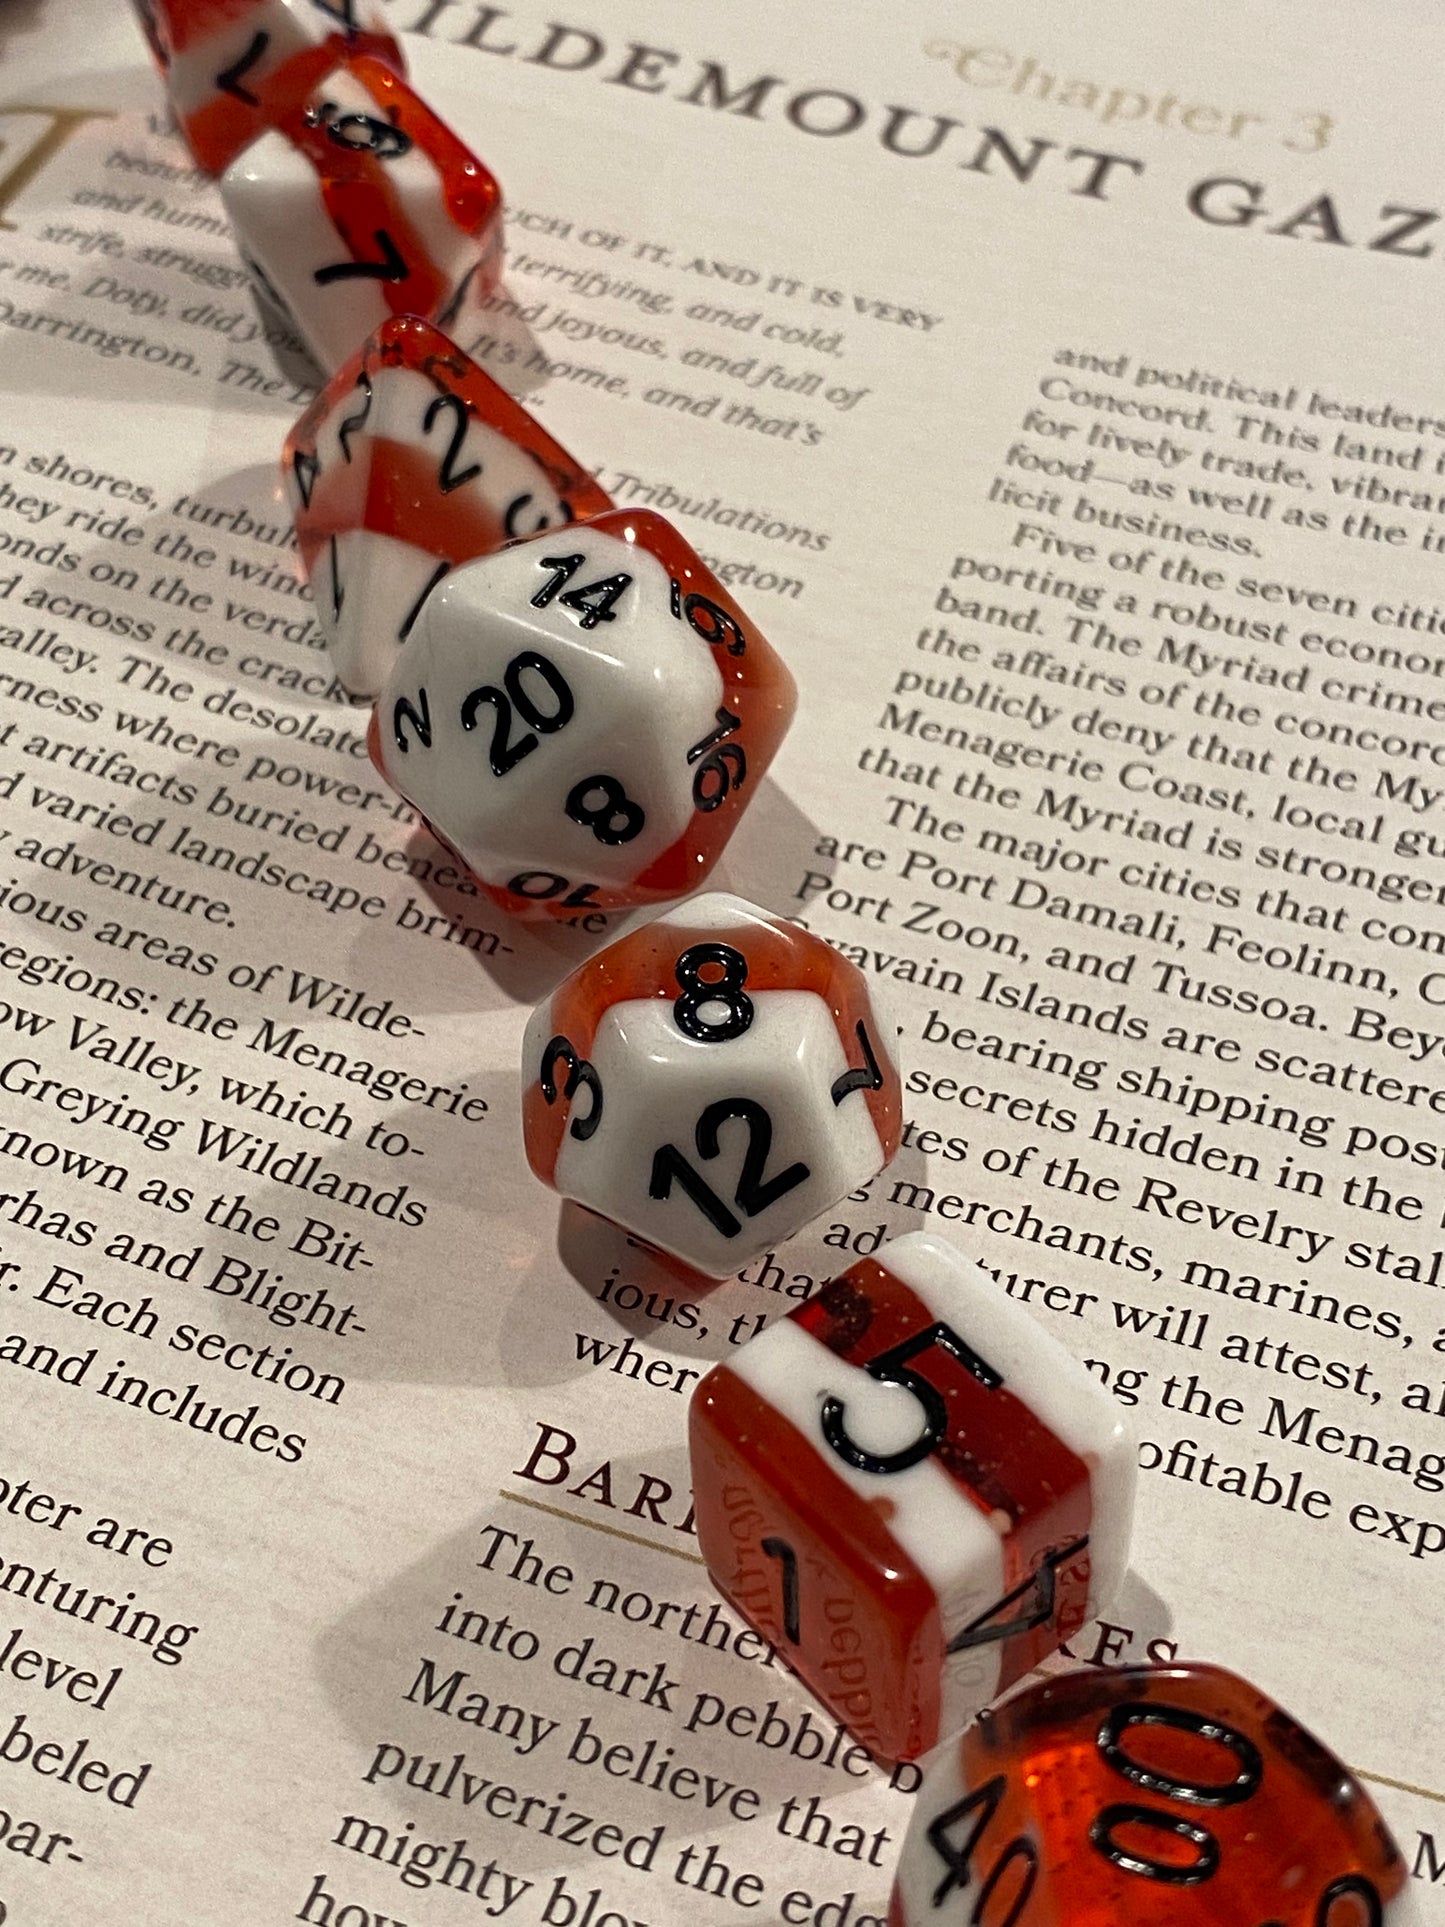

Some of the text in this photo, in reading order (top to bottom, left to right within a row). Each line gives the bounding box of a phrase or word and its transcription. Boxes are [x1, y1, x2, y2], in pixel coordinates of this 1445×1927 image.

[1186, 175, 1442, 258] GAZ
[686, 304, 762, 332] and
[218, 359, 284, 396] The
[643, 388, 722, 417] and
[681, 349, 758, 379] and
[748, 365, 824, 396] full
[1054, 350, 1128, 377] and
[1135, 367, 1298, 410] political
[25, 455, 156, 509] shores,
[424, 394, 482, 493] 2
[1023, 410, 1078, 440] for
[1088, 423, 1191, 468] lively
[1237, 415, 1319, 451] This
[1334, 433, 1424, 471] land
[65, 511, 216, 567] ride the
[608, 473, 831, 551] Tribulations
[1073, 497, 1261, 558] business.
[1188, 488, 1407, 544] well as the
[90, 564, 212, 612] on the
[531, 554, 632, 629] 14
[951, 557, 1287, 645] porting a robust
[1014, 523, 1357, 617] Five of the seven
[23, 590, 229, 665] across the
[917, 629, 1261, 725] the affairs of the
[936, 587, 1310, 692] band. The Myriad
[119, 655, 194, 702] The
[461, 651, 575, 777] 20
[116, 711, 240, 767] where
[879, 703, 1384, 843] Menagerie Coast, local
[894, 671, 1357, 791] publicly deny that the
[22, 736, 351, 853] artifacts buried
[565, 775, 645, 846] 8
[858, 748, 1242, 859] that the Myriad is
[14, 839, 235, 928] adventure.
[31, 787, 166, 847] varied
[167, 826, 386, 918] landscape
[396, 898, 514, 956] brim-
[888, 796, 1348, 933] The major cities that
[795, 871, 1327, 1031] Port Zoon, and Tussoa.
[815, 837, 1398, 999] are Port Damali, Feolinn,
[94, 922, 425, 1038] areas of Wilde-
[674, 943, 755, 1043] 8
[977, 972, 1241, 1062] Islands are
[70, 1015, 424, 1157] Valley, which to-
[166, 998, 488, 1122] the Menagerie
[540, 1035, 604, 1142] 3
[922, 1010, 1335, 1148] bearing shipping
[0, 1058, 427, 1227] Greying Wildlands
[649, 1097, 811, 1238] 12
[905, 1071, 1423, 1221] secrets hidden in the
[138, 1180, 373, 1271] as the Bit-
[982, 1146, 1335, 1263] of the Revelry
[104, 1234, 366, 1337] and Blight-
[887, 1181, 1413, 1349] merchants, marines,
[33, 1265, 345, 1405] Each section
[1112, 1302, 1381, 1405] will attest,
[0, 1335, 306, 1463] and includes
[821, 1322, 1003, 1474] 5
[1162, 1375, 1244, 1426] the
[86, 1518, 173, 1567] are
[477, 1524, 574, 1595] The
[435, 1592, 873, 1777] into dark pebble
[402, 1658, 891, 1867] Many believe that
[331, 1816, 534, 1917] mighty
[362, 1743, 764, 1908] pulverized the
